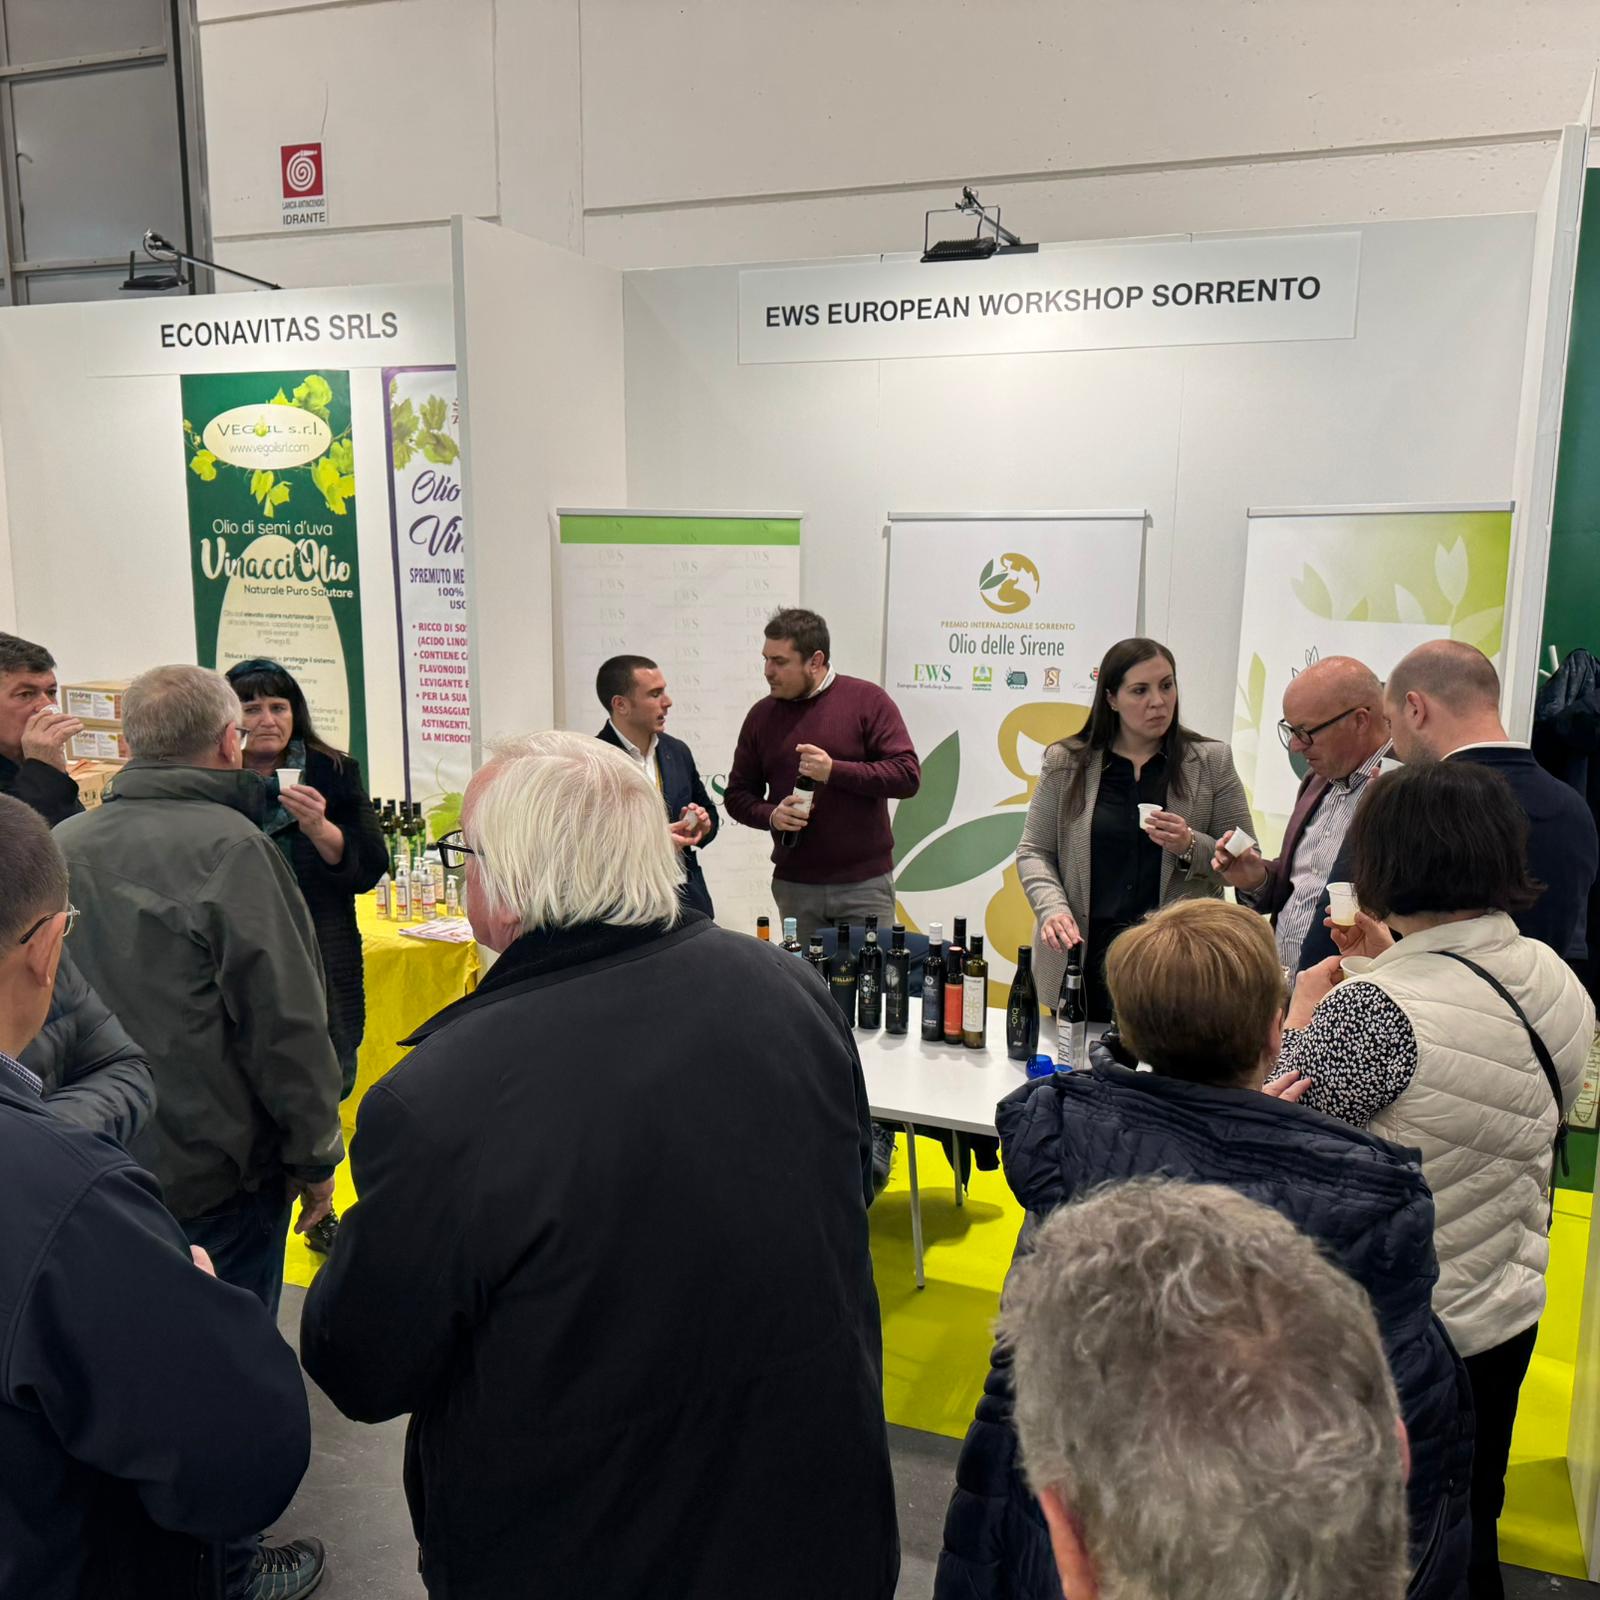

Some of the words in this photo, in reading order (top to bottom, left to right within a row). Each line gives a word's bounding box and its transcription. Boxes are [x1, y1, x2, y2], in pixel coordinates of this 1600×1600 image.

[282, 211, 326, 225] IDRANTE
[765, 304, 820, 328] EWS
[827, 296, 971, 325] EUROPEAN
[978, 286, 1144, 316] WORKSHOP
[1151, 275, 1322, 308] SORRENTO
[160, 316, 321, 348] ECONAVITAS
[328, 311, 398, 341] SRLS
[287, 421, 323, 437] s.r.l.
[411, 469, 462, 505] Olio
[212, 518, 239, 535] Olio
[241, 519, 255, 535] di
[257, 520, 290, 536] semi
[293, 520, 334, 536] d'uva
[200, 536, 351, 584] VinacciOlio
[409, 567, 452, 584] SPREMUTO
[452, 568, 465, 584] ME
[244, 584, 285, 595] Naturale
[286, 586, 309, 597] Puro
[311, 586, 354, 599] Salutare
[438, 587, 464, 597] 100%
[418, 622, 442, 632] RICCO
[444, 623, 453, 632] DI
[454, 623, 468, 633] SO
[940, 620, 969, 630] PREMIO
[970, 621, 1034, 631] INTERNAZIONALE
[1035, 622, 1076, 631] SORRENTO
[417, 636, 445, 648] (ACIDO
[949, 633, 977, 655] Olio
[981, 634, 1015, 655] delle
[1020, 635, 1065, 656] Sirene
[419, 650, 460, 661] CONTIENE
[419, 663, 466, 675] FLAVONOIDI
[914, 663, 952, 682] EWS
[419, 678, 463, 689] LEVIGANTE
[421, 692, 438, 701] PER
[439, 693, 450, 702] LA
[451, 693, 467, 703] SUA
[421, 705, 471, 716] MASSAGGIAT
[422, 732, 432, 742] LA
